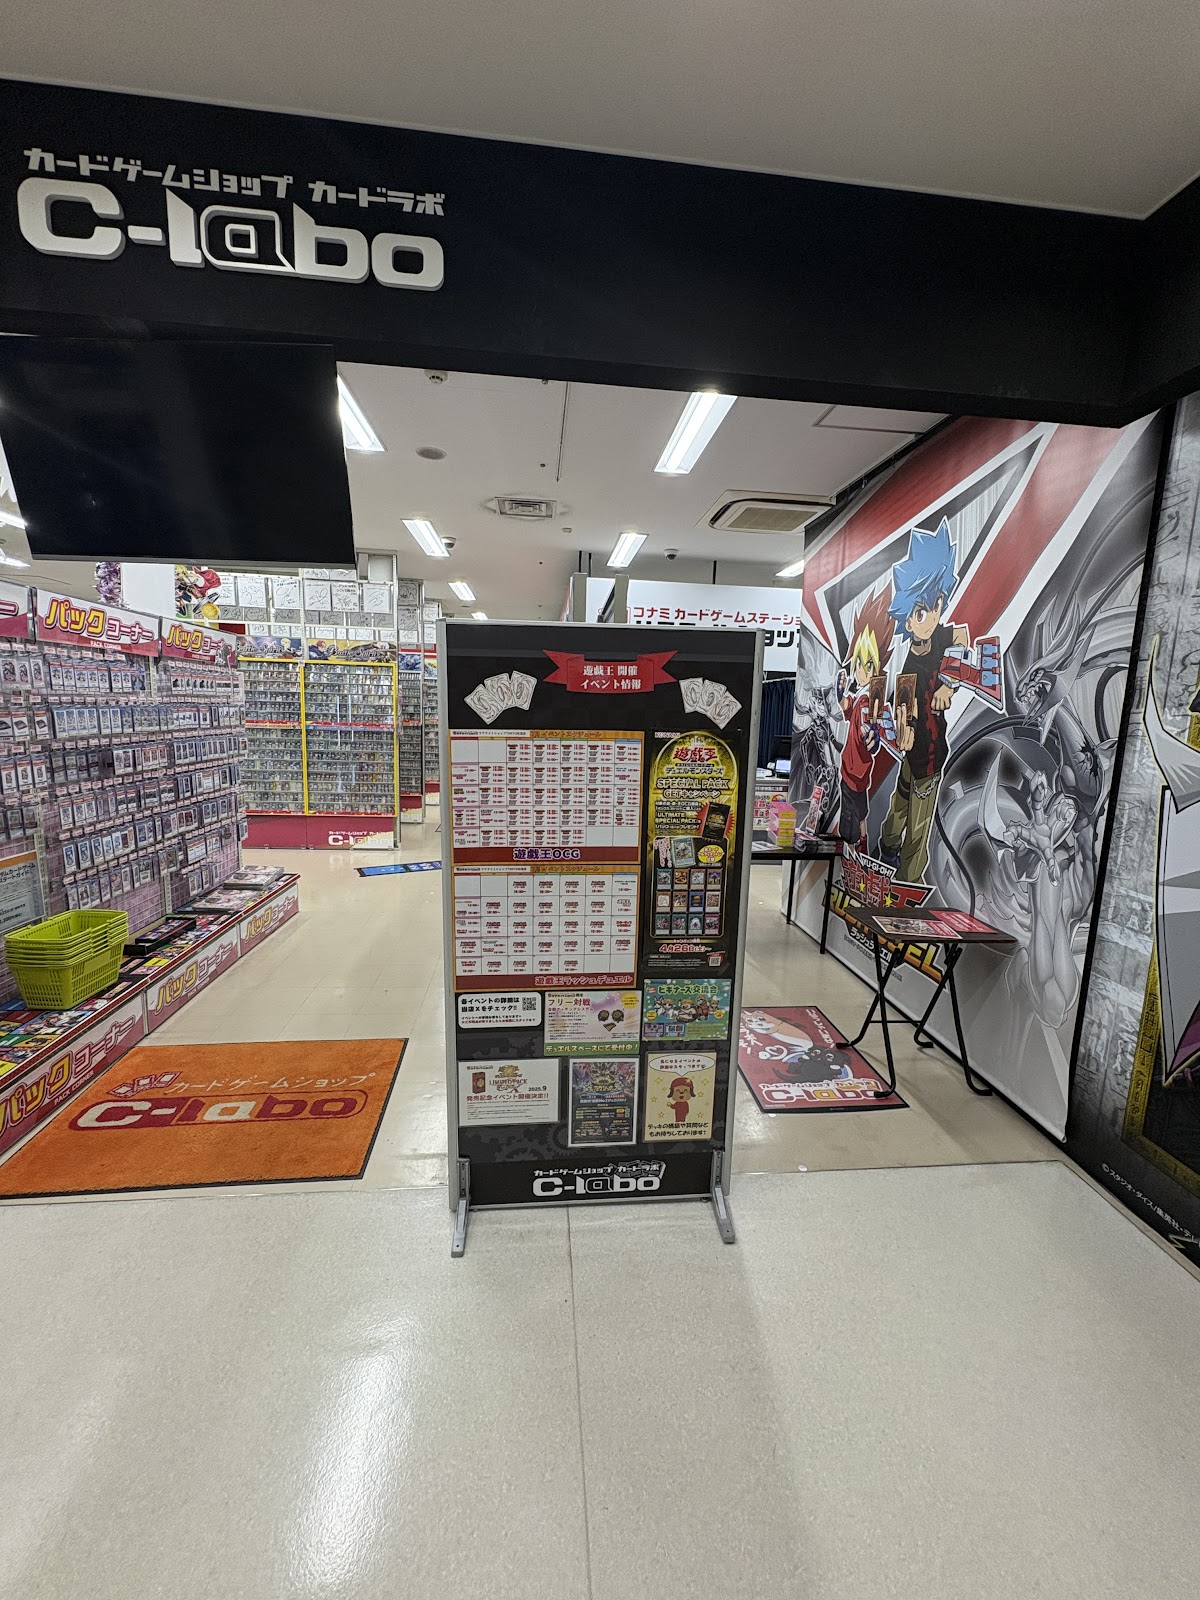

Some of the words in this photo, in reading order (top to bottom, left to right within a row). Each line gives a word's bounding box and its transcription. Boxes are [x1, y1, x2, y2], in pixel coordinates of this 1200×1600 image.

[23, 147, 293, 198] カードゲームショップ
[307, 180, 446, 216] カードラボ
[633, 607, 671, 619] コナミ
[583, 665, 614, 677] 遊戯王
[617, 665, 638, 677] 開催
[580, 678, 641, 691] イベント情報
[673, 746, 718, 763] 遊戯王
[657, 779, 702, 789] SPECIAL
[702, 779, 729, 789] PACK
[513, 848, 580, 860] 遊戯王OCG
[154, 943, 233, 1016] パックコーナー
[534, 974, 633, 986] 遊戯王ラッシュデュエル
[548, 998, 591, 1007] フリー対戦
[53, 1091, 71, 1106] PACK
[71, 1071, 95, 1092] CORNER
[164, 1072, 376, 1094] カードゲームショップ
[534, 1166, 614, 1176] カードゲームショップ
[618, 1164, 660, 1173] カードラボ
